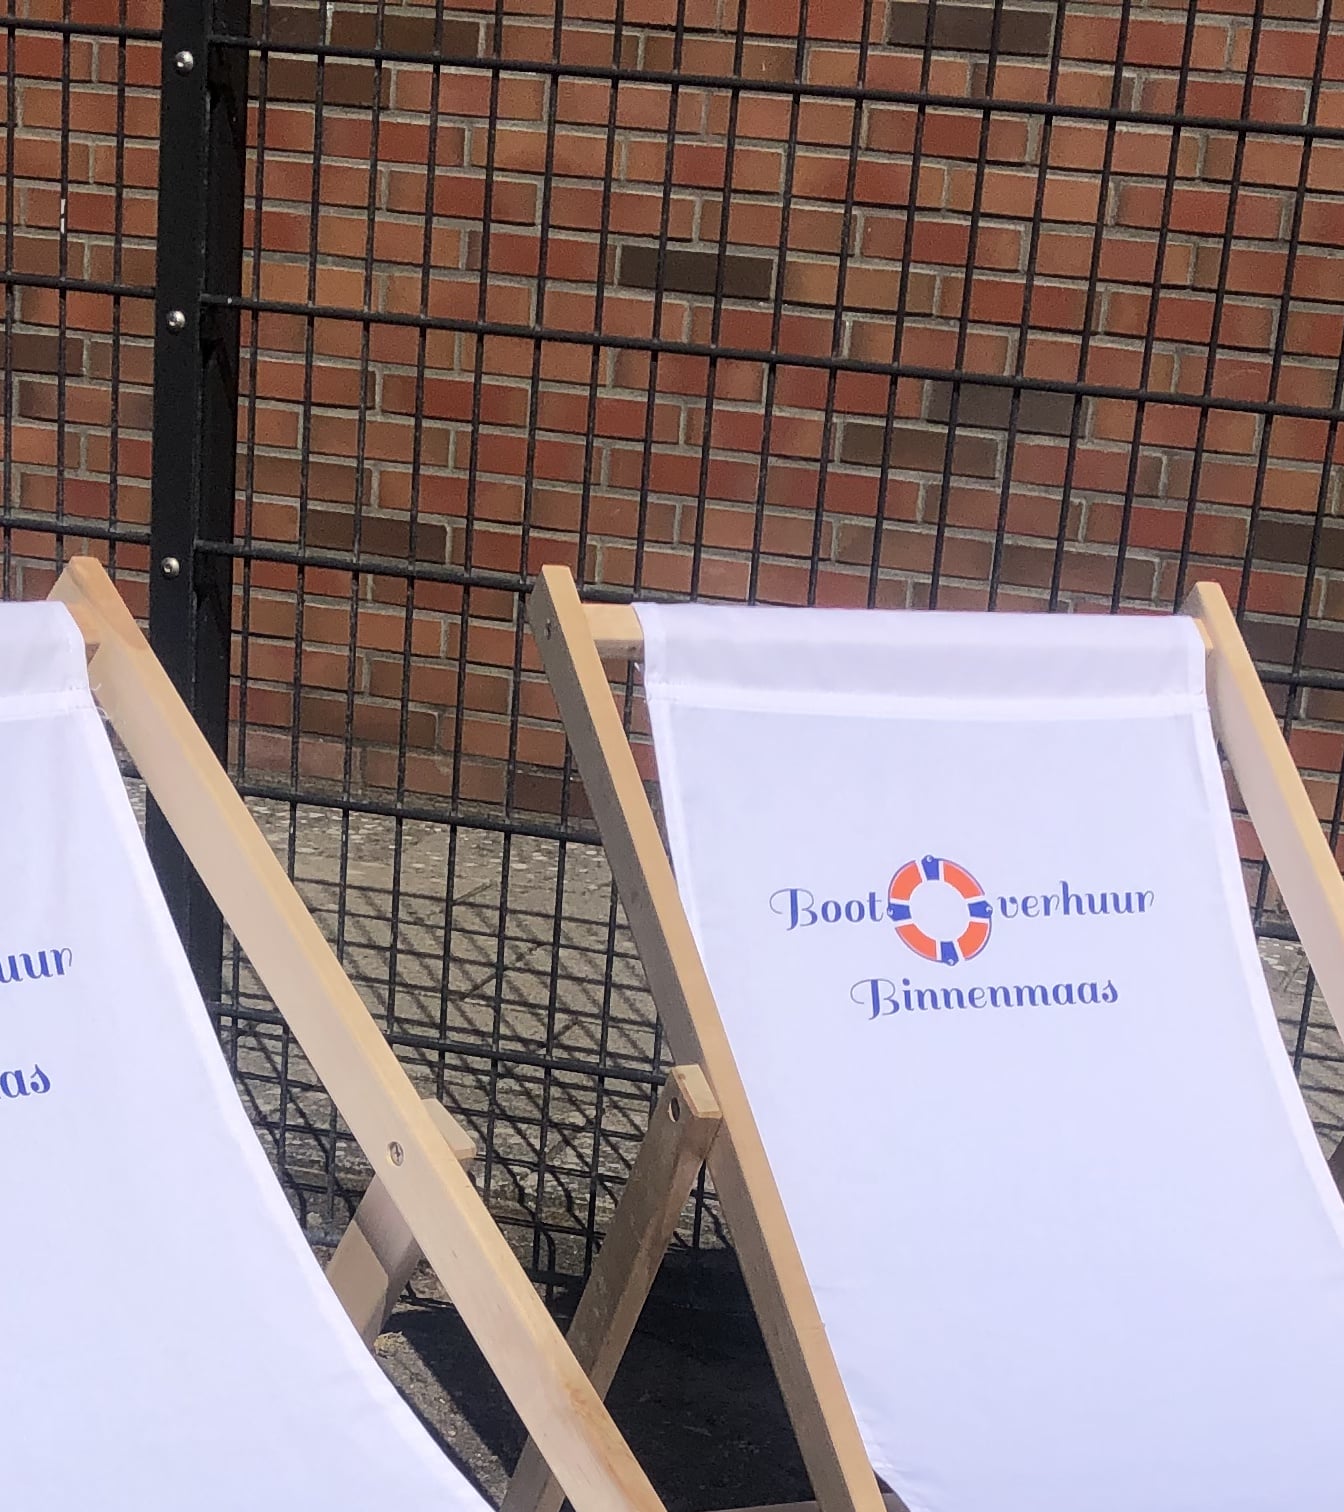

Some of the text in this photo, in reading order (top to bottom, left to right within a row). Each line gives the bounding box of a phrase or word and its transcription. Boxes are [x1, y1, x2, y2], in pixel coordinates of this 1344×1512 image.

[769, 880, 1154, 931] Boot verhuur
[850, 978, 1118, 1020] Binnenmaas
